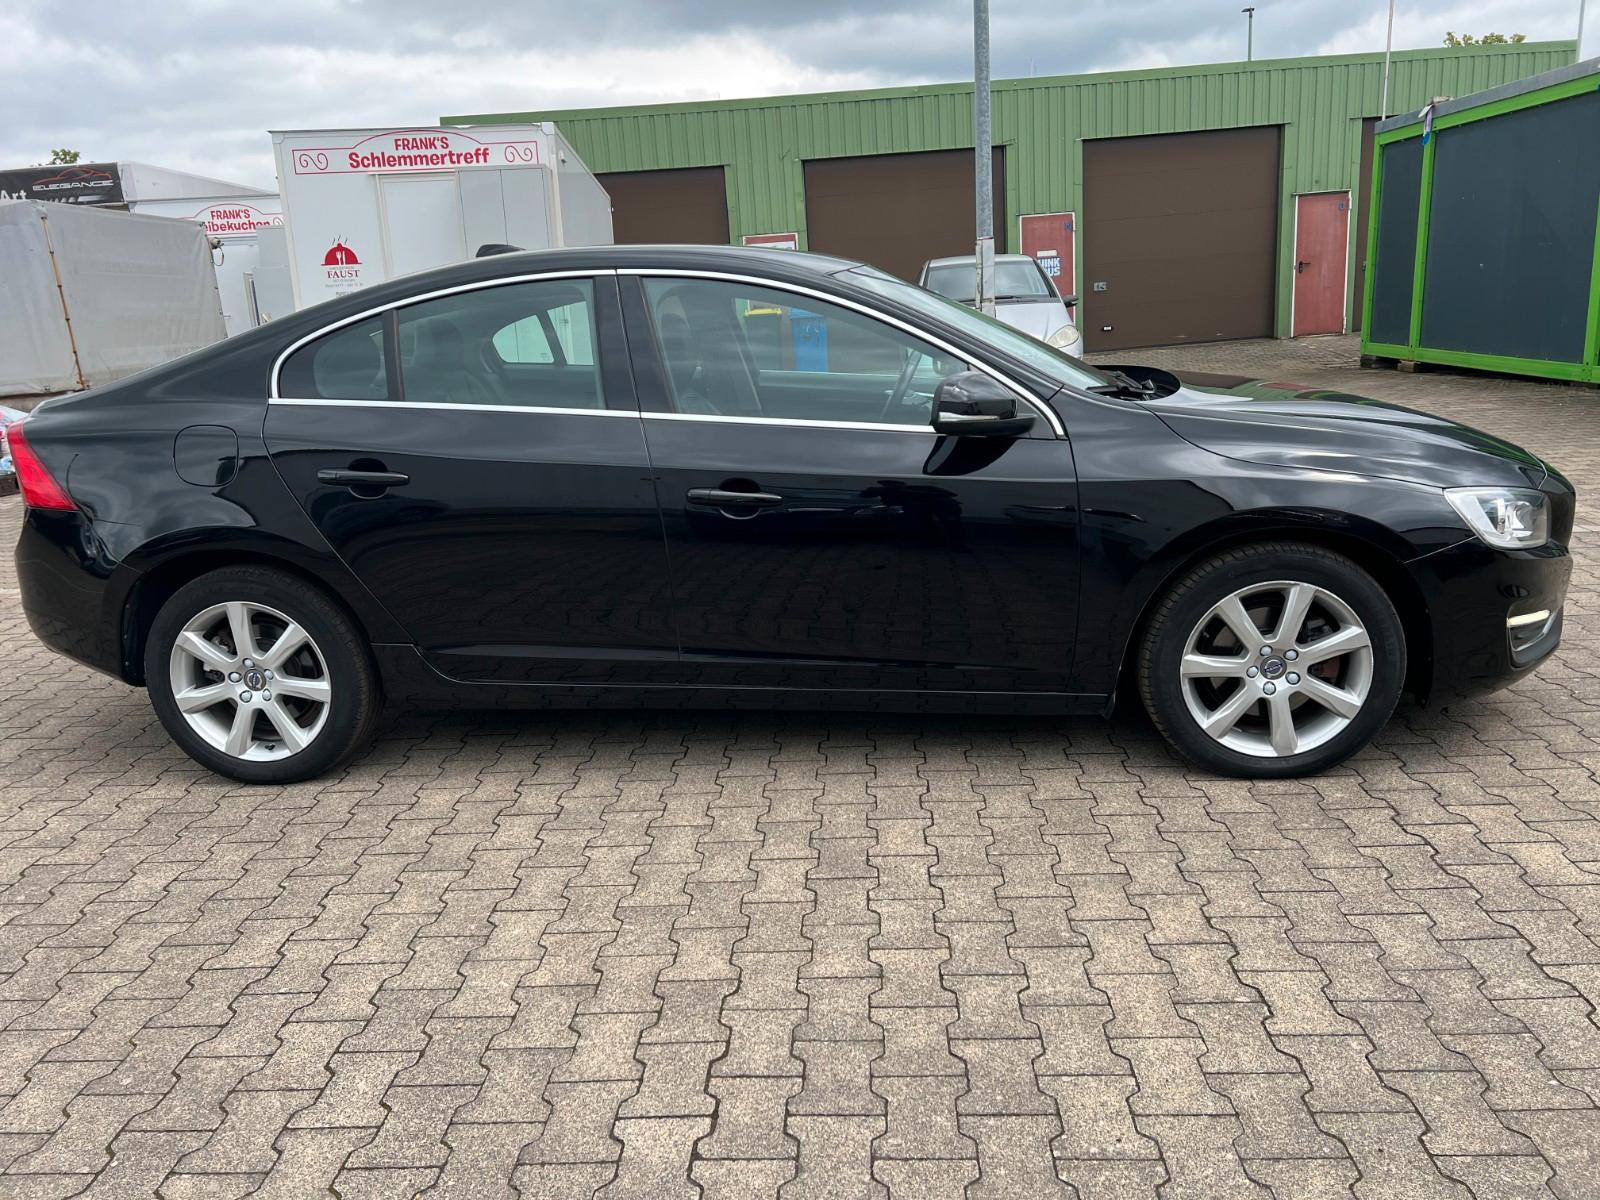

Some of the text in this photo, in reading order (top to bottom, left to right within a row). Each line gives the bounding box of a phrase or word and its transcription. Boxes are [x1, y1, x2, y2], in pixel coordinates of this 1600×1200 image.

[394, 136, 449, 151] FRANK'S
[348, 148, 490, 169] Schlemmertreff
[32, 180, 114, 191] ELEGANCE
[210, 209, 251, 221] FRANK'S
[327, 269, 360, 279] FAUST
